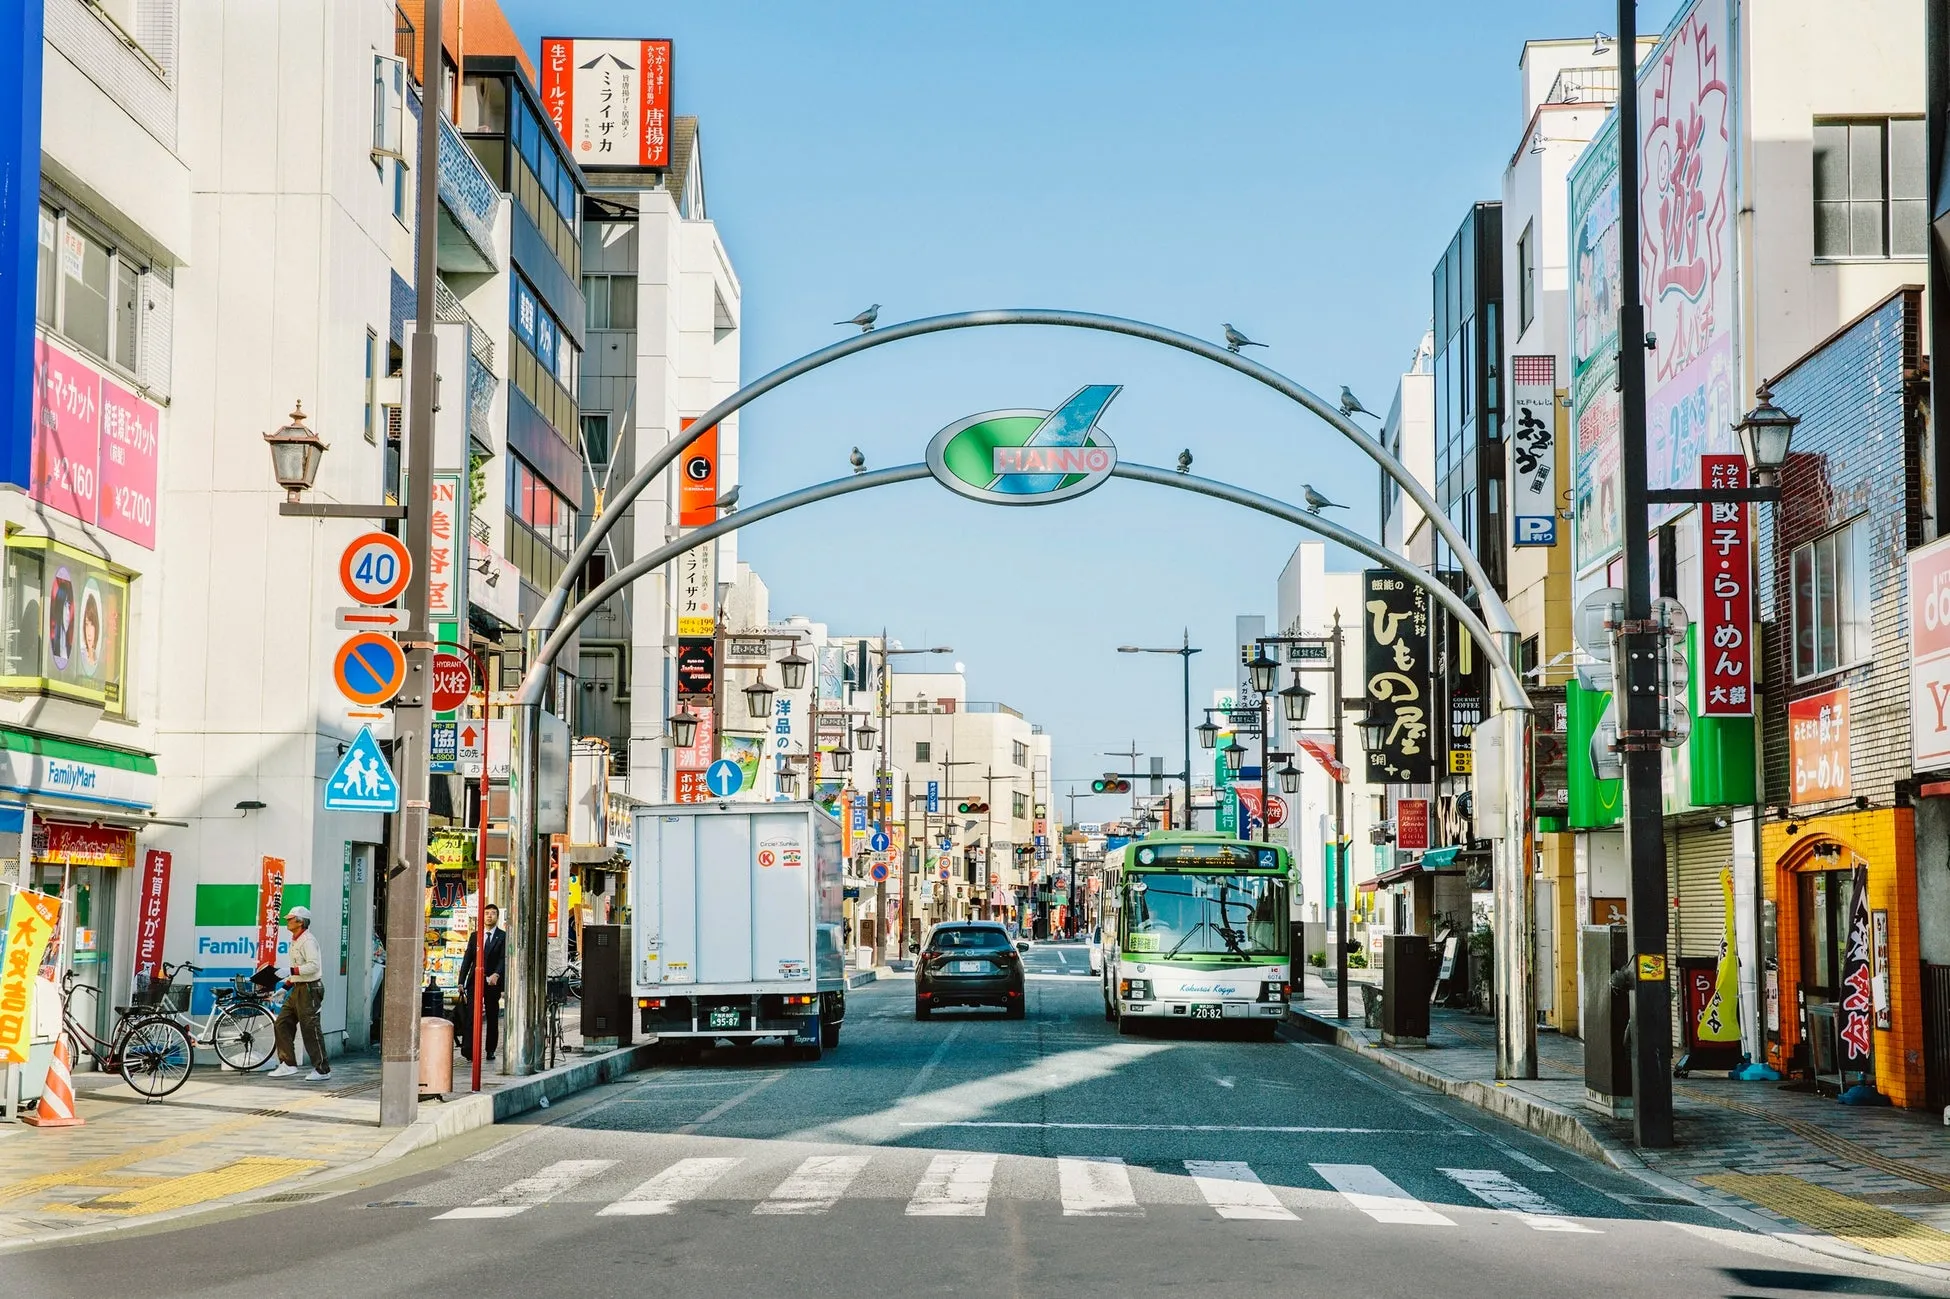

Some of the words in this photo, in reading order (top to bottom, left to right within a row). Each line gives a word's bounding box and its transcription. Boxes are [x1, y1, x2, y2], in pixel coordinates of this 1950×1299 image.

[550, 44, 566, 98] 生ビール
[599, 71, 614, 153] ミライザカ
[645, 107, 665, 161] 唐揚げ
[689, 459, 708, 479] G
[1711, 464, 1724, 489] だれ
[1726, 464, 1739, 489] みそ
[115, 486, 152, 528] ¥2,700
[1519, 518, 1552, 541] P
[355, 552, 395, 585] 40
[433, 671, 468, 693] 火栓
[1366, 600, 1427, 755] ひもの屋
[775, 699, 791, 749] 洋品の
[1820, 703, 1844, 743] 餃子
[433, 729, 455, 748] 協
[459, 749, 479, 758] この先
[47, 761, 97, 791] FamilyMart
[1795, 752, 1845, 793] らーめん
[680, 773, 693, 803] ホルモ
[199, 935, 292, 958] Familya
[1179, 984, 1210, 993] Kokusai
[1212, 984, 1236, 996] Kogyo
[716, 1018, 738, 1026] 95-87
